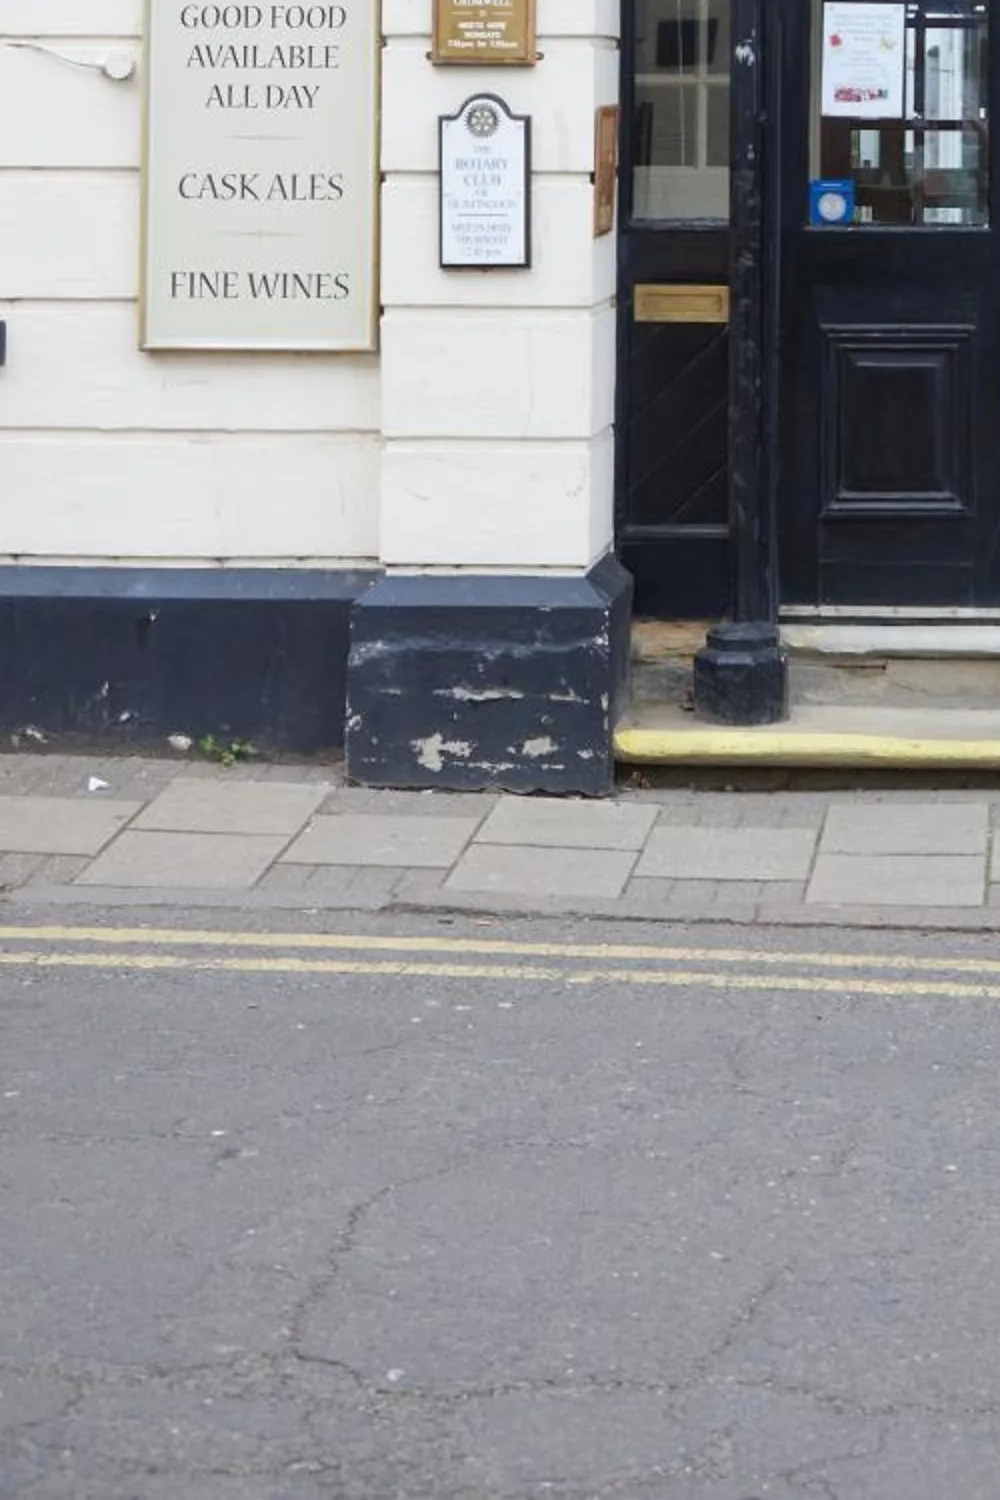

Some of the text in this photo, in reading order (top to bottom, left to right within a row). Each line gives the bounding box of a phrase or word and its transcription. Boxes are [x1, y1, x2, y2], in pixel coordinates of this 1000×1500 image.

[179, 3, 348, 30] GOOD FOOD
[186, 43, 340, 70] AVAILABLE
[204, 83, 321, 110] ALL DAY
[178, 173, 344, 201] CASK ALES
[170, 271, 350, 301] FINE WINES
